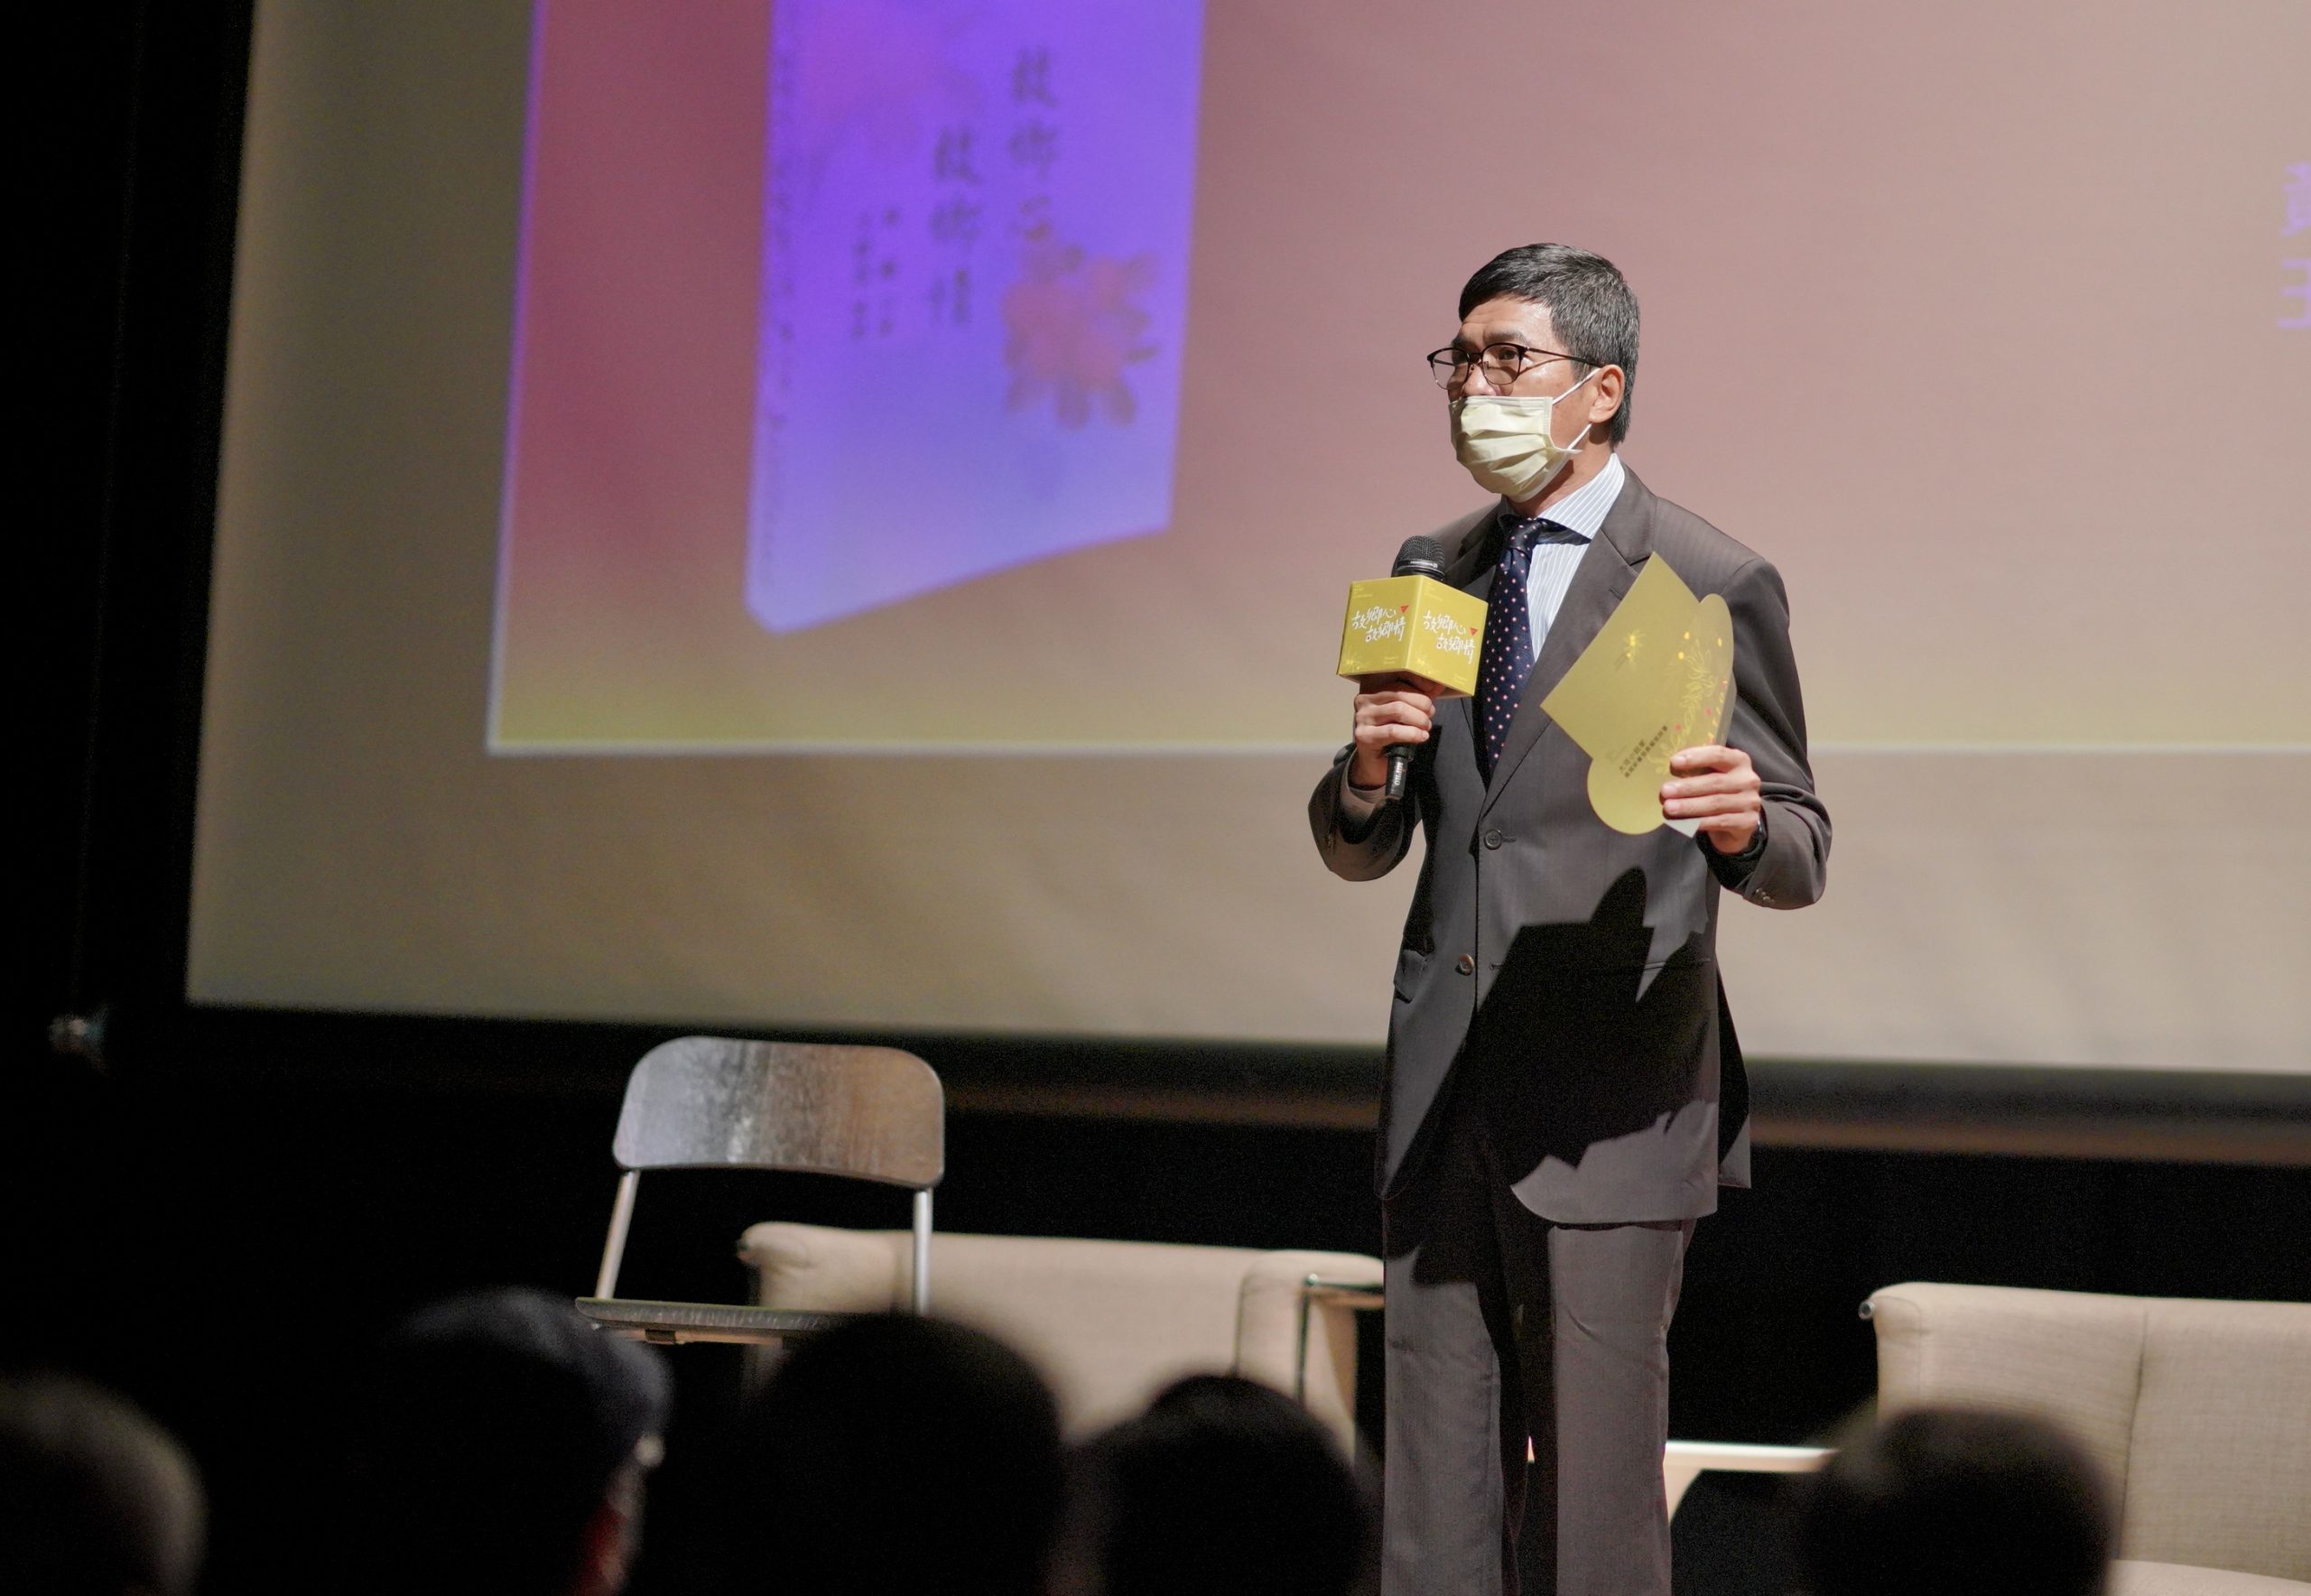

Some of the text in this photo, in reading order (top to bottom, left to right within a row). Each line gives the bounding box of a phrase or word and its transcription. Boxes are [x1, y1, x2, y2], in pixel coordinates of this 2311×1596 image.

[1351, 606, 1397, 629] 故鄉心
[1365, 616, 1406, 642] 故鄉情
[1423, 609, 1467, 636] 故鄉心
